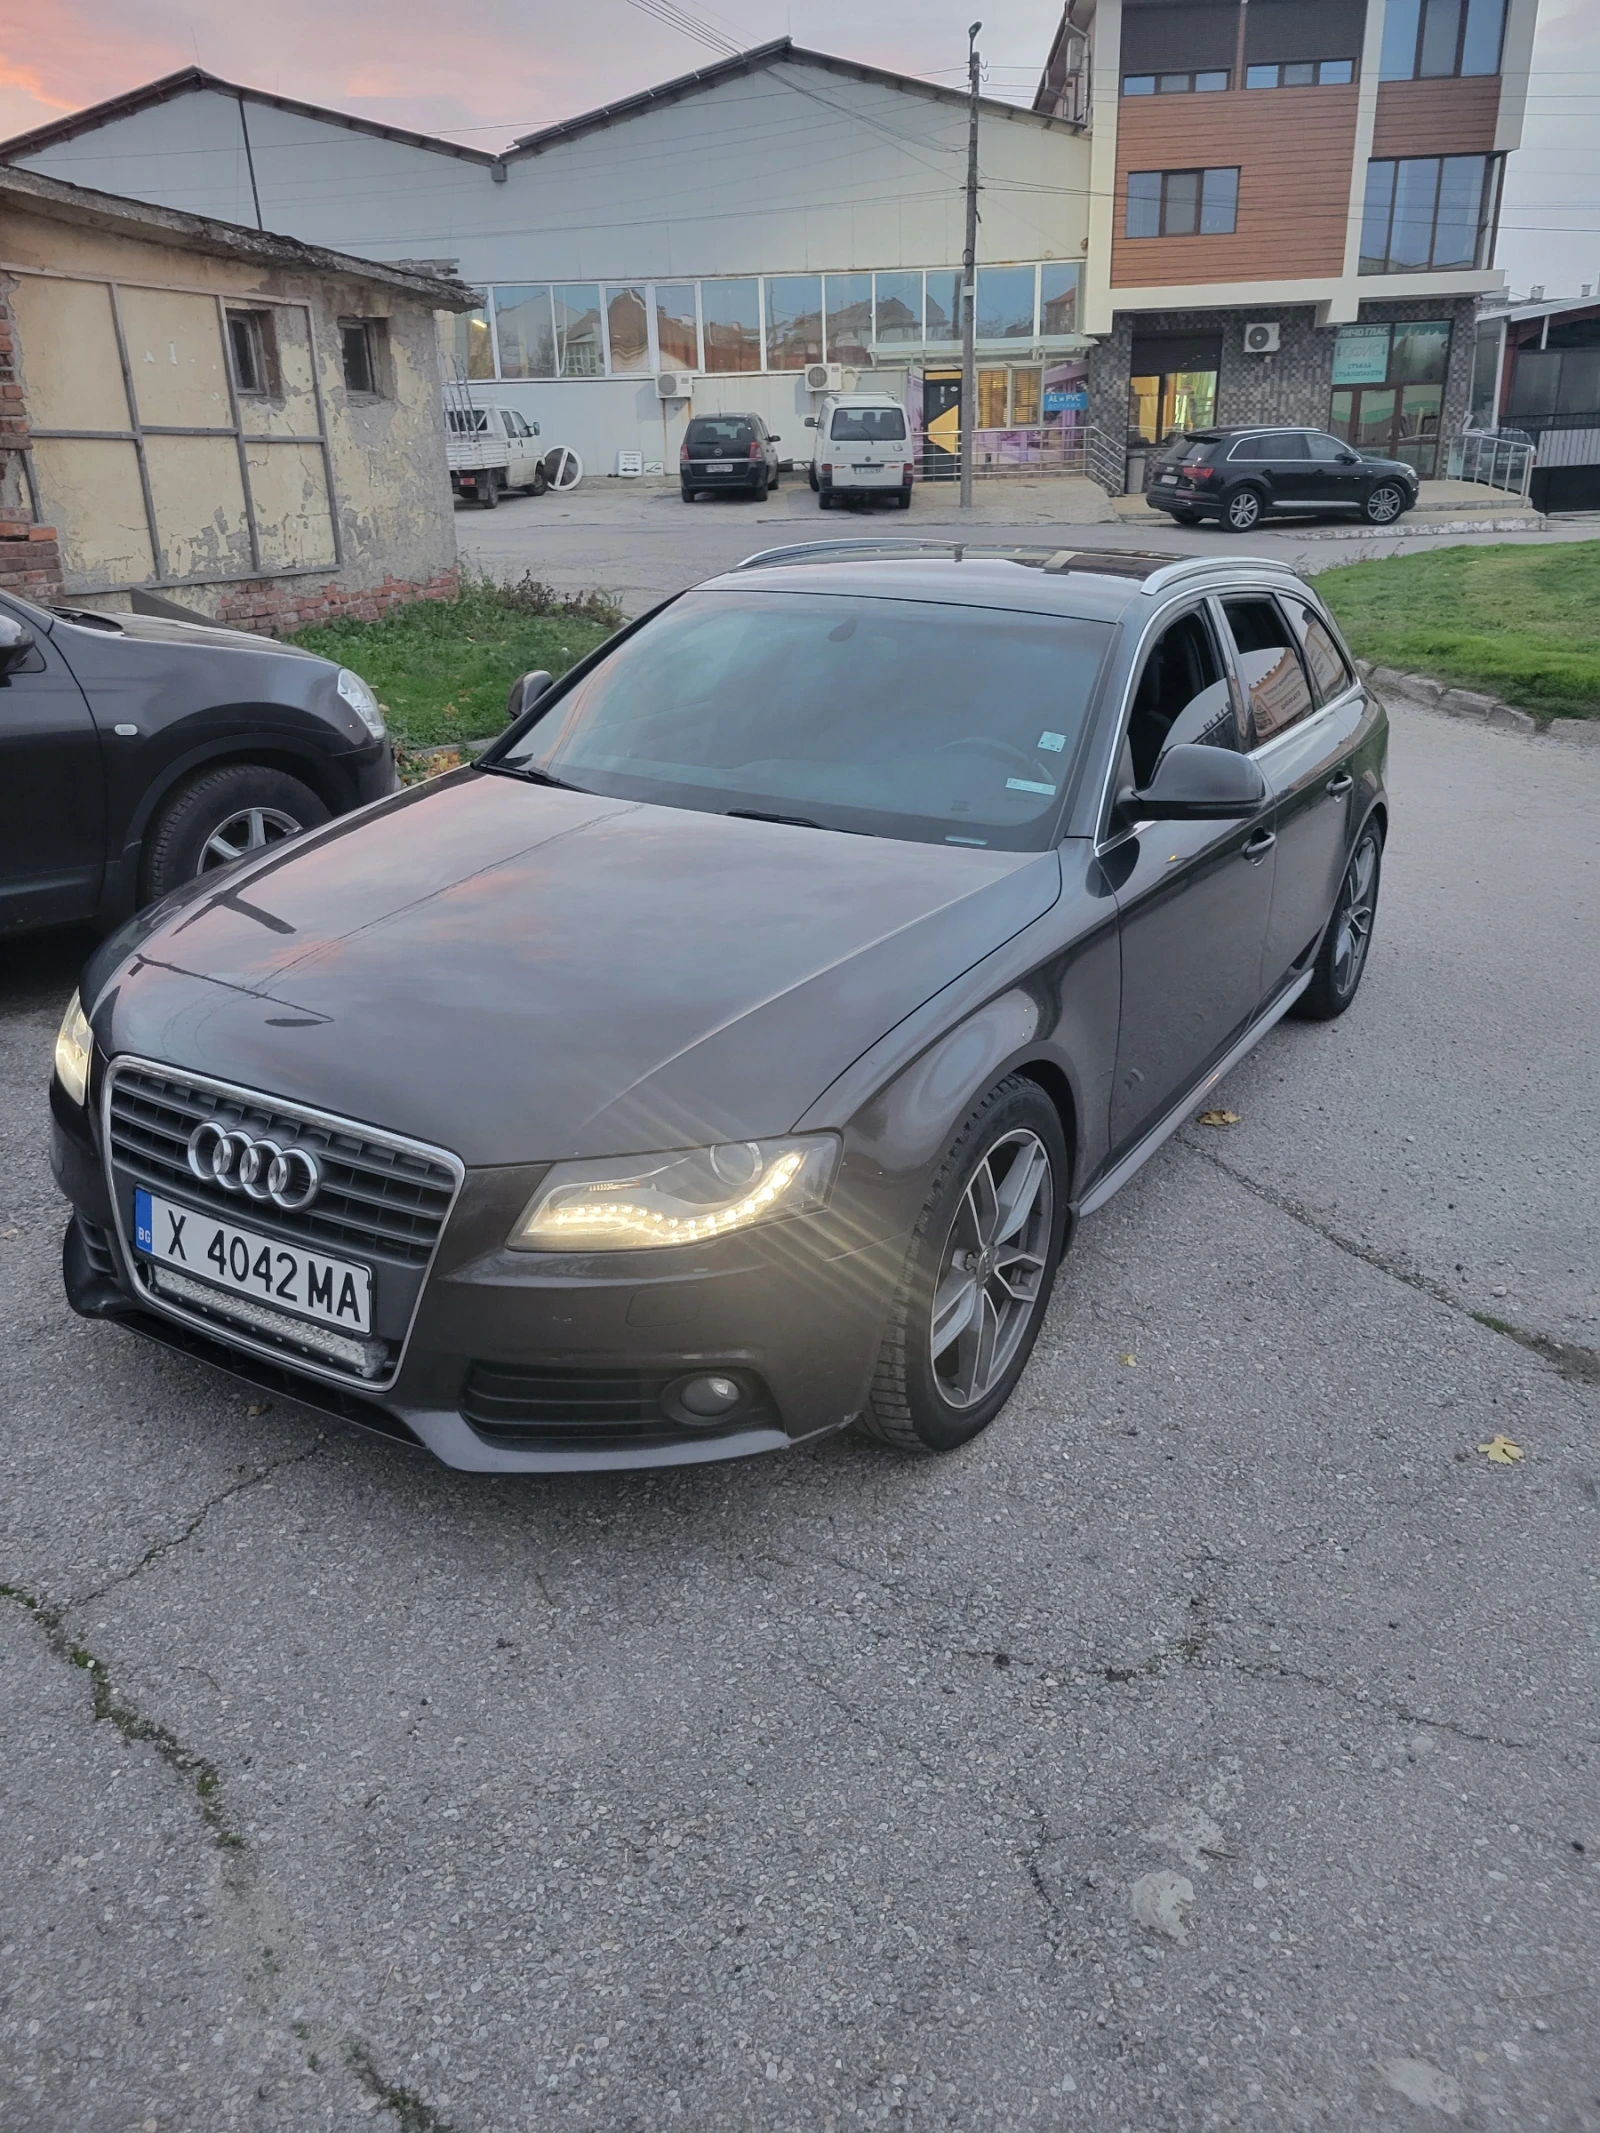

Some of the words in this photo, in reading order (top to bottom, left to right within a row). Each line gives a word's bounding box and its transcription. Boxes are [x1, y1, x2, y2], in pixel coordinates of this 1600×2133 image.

[1366, 327, 1388, 336] ГЛАС
[138, 1228, 151, 1244] BG
[168, 1209, 187, 1262] X
[207, 1229, 298, 1302] 4042
[308, 1260, 361, 1323] MA
